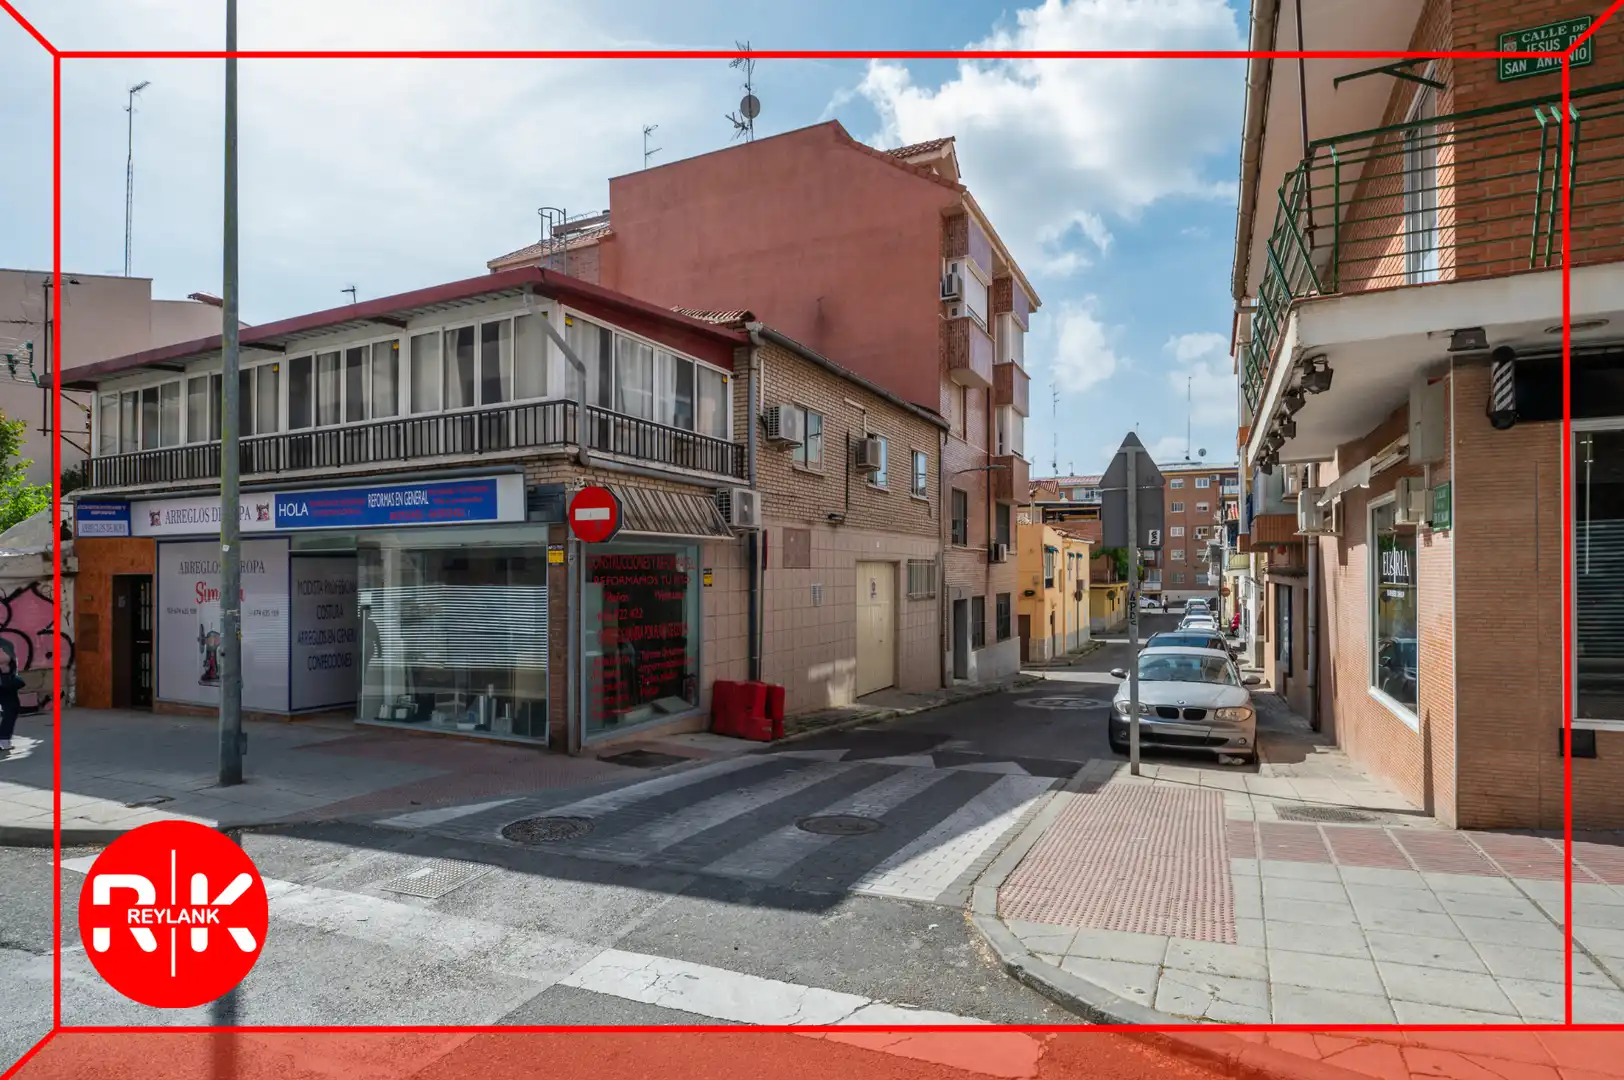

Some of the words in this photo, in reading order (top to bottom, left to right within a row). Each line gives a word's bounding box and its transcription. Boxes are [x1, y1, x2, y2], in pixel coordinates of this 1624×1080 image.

[1521, 25, 1568, 43] CALLE
[1572, 23, 1587, 33] DE
[1526, 38, 1561, 53] JESUS
[1504, 59, 1528, 75] SAN
[367, 492, 394, 508] REFORMAS
[395, 492, 404, 507] EN
[404, 490, 430, 506] GENERAL
[165, 506, 210, 524] ARREGLOS
[278, 502, 309, 517] HOLA
[240, 560, 266, 574] ROPA
[593, 575, 658, 586] REFORMAMOS
[661, 575, 672, 585] TU
[316, 603, 343, 620] COSTURA
